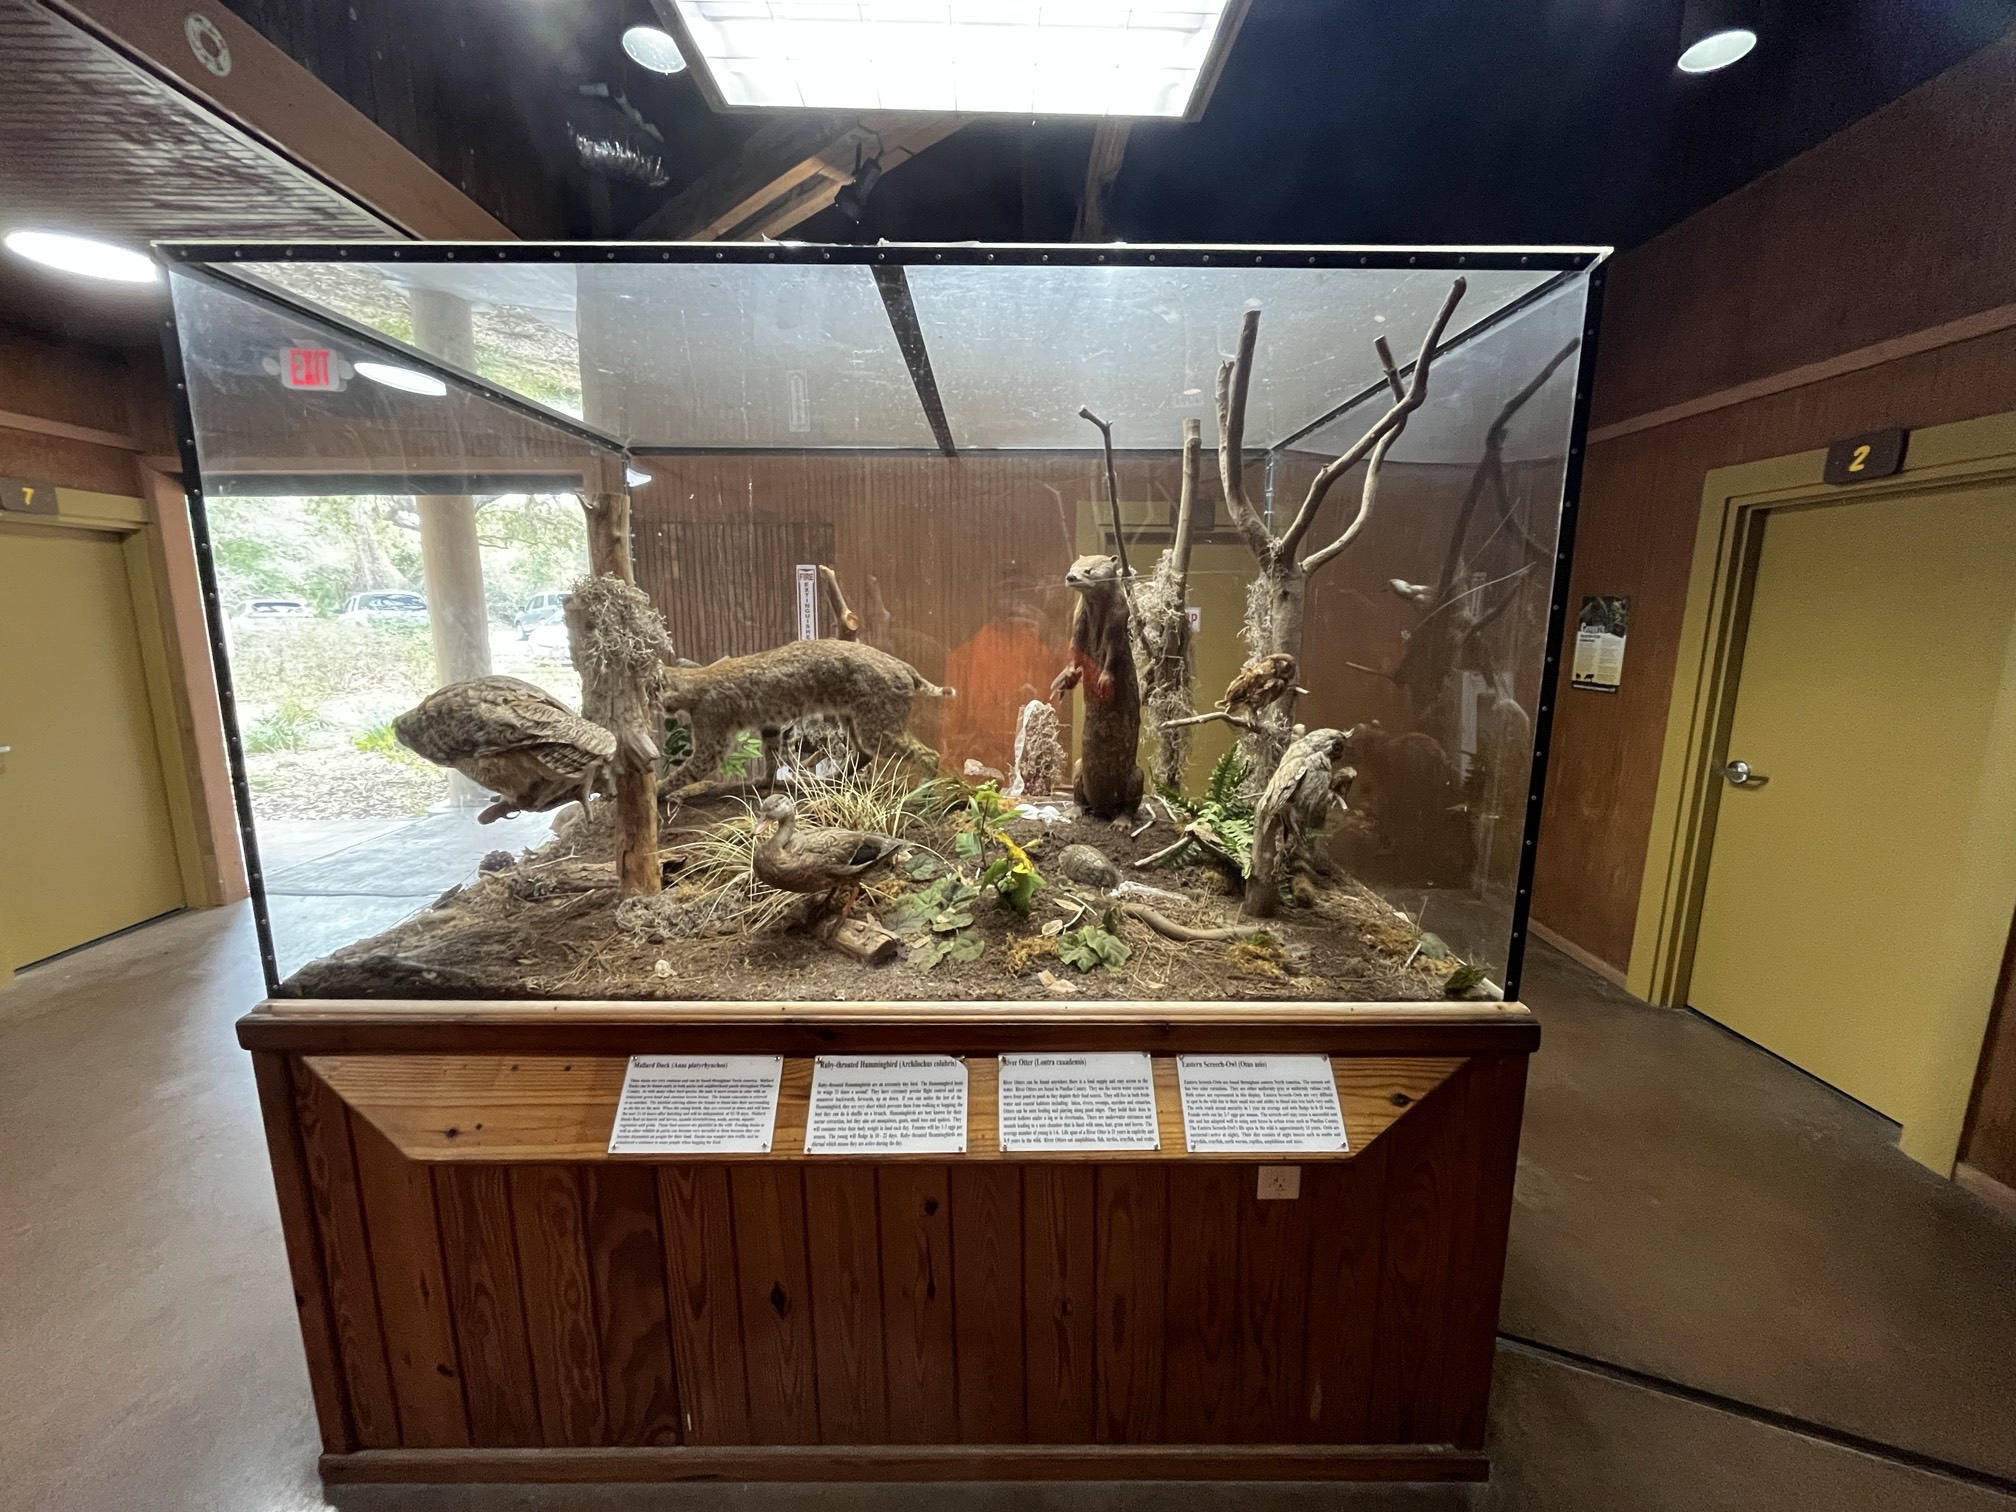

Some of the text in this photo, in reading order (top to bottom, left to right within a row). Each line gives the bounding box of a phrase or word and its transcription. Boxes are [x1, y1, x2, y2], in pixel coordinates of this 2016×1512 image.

[289, 348, 329, 385] EXIT
[1849, 445, 1870, 472] 2
[800, 573, 814, 581] FIRE
[860, 1061, 898, 1069] Hummingbird
